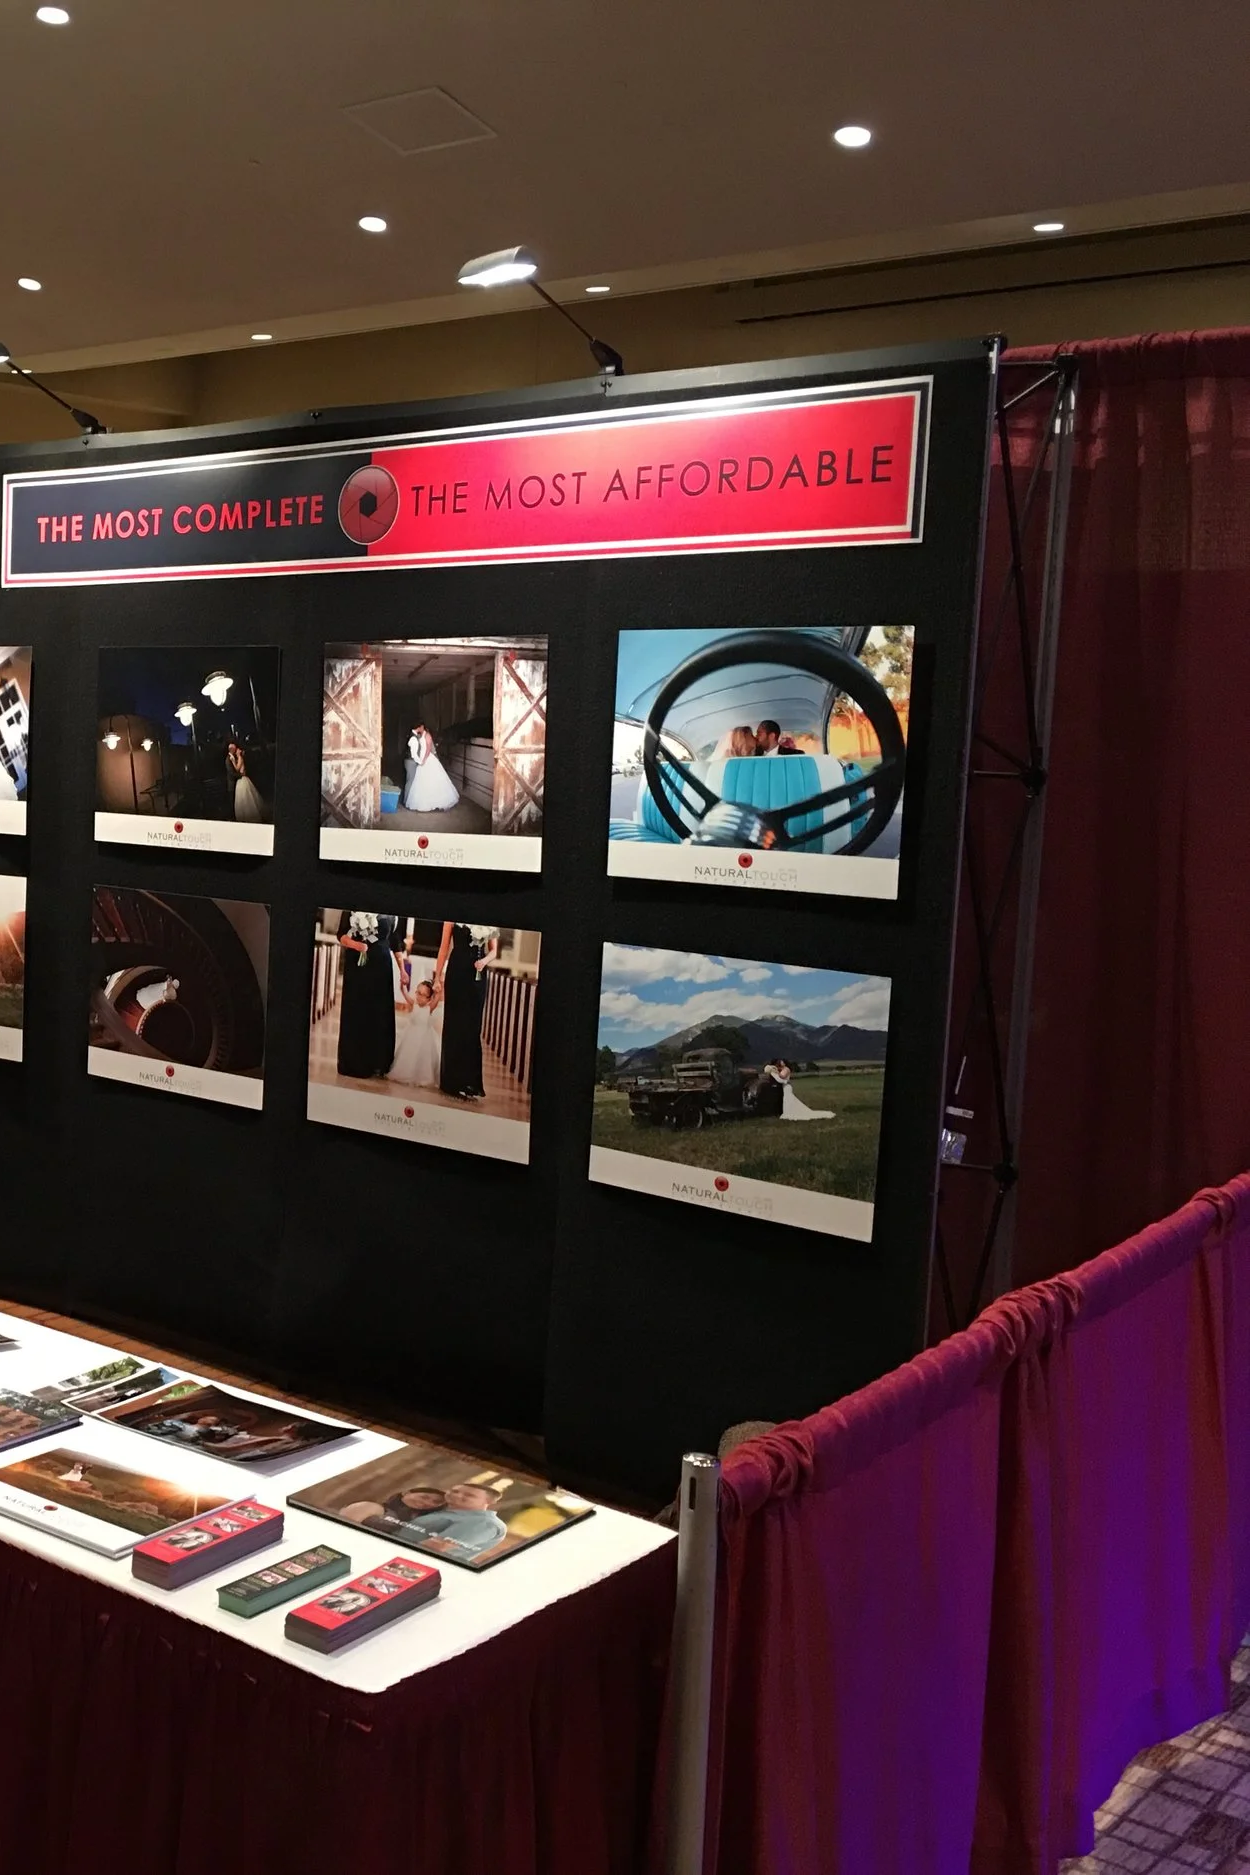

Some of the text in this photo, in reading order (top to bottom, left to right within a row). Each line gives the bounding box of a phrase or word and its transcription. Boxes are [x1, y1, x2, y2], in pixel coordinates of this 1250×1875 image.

[37, 445, 895, 543] THE MOST COMPLETE THE MOST AFFORDABLE
